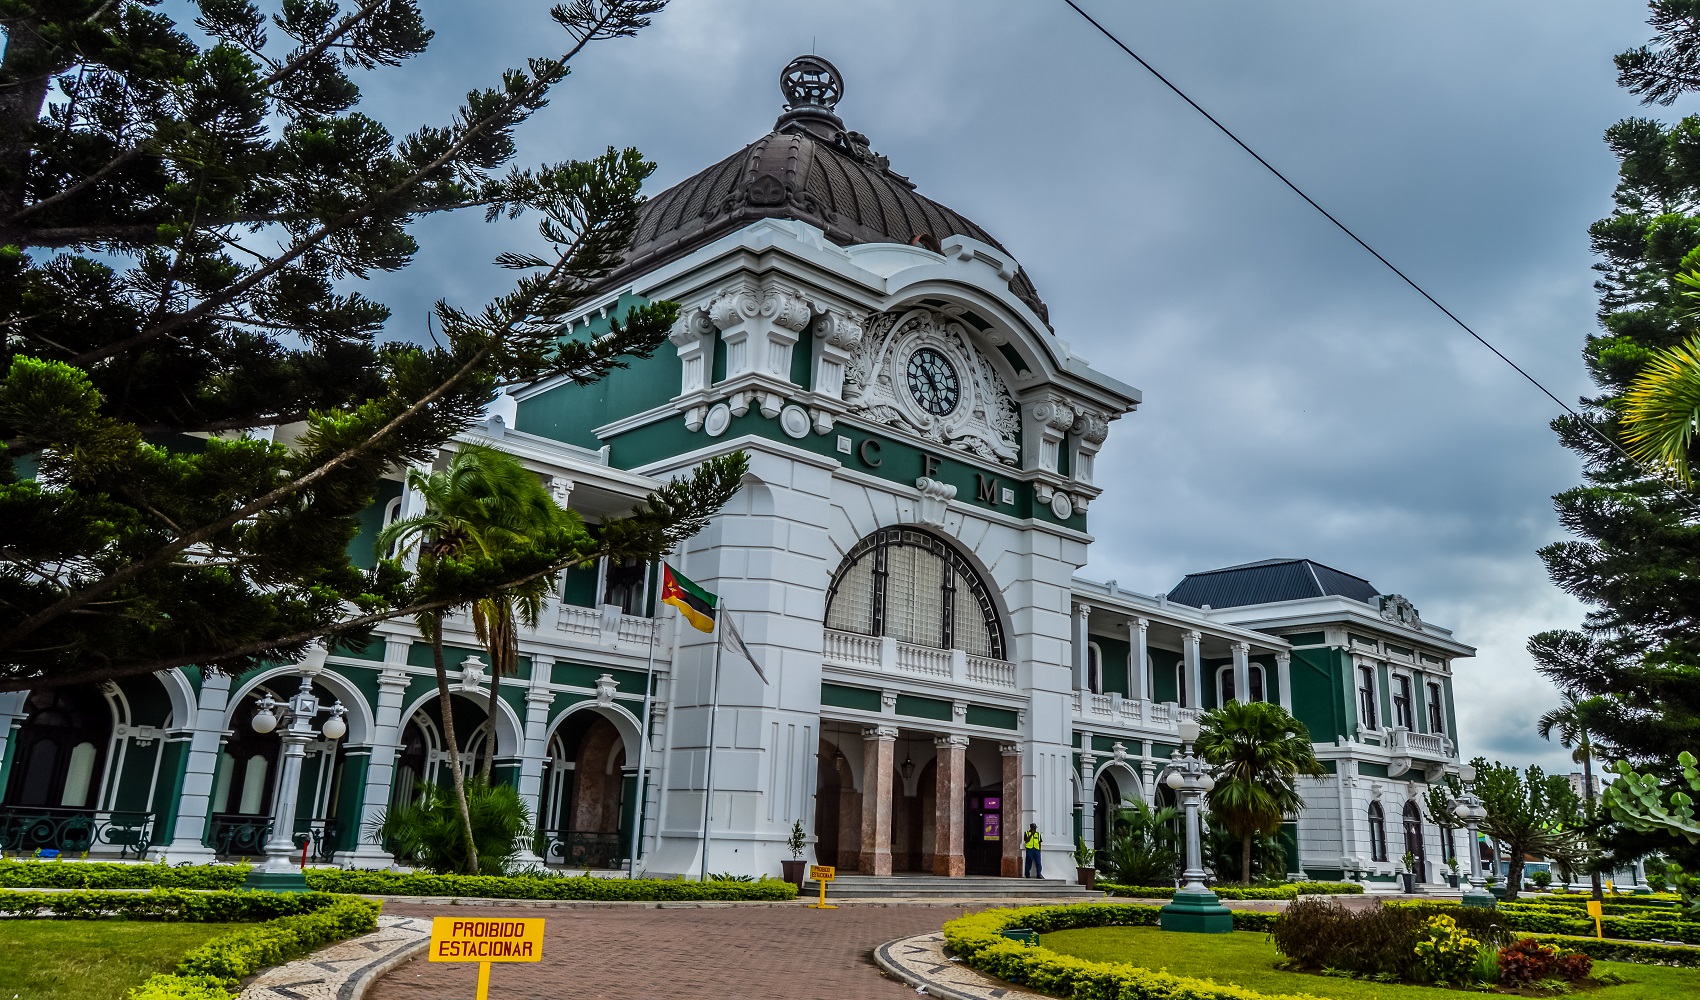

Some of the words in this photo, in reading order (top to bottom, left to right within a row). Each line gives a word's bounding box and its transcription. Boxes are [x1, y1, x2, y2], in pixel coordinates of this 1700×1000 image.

[861, 439, 882, 467] C
[923, 452, 943, 477] F
[977, 473, 999, 506] M
[452, 922, 525, 937] PROIBIDO
[439, 941, 533, 956] ESTACIONAR
